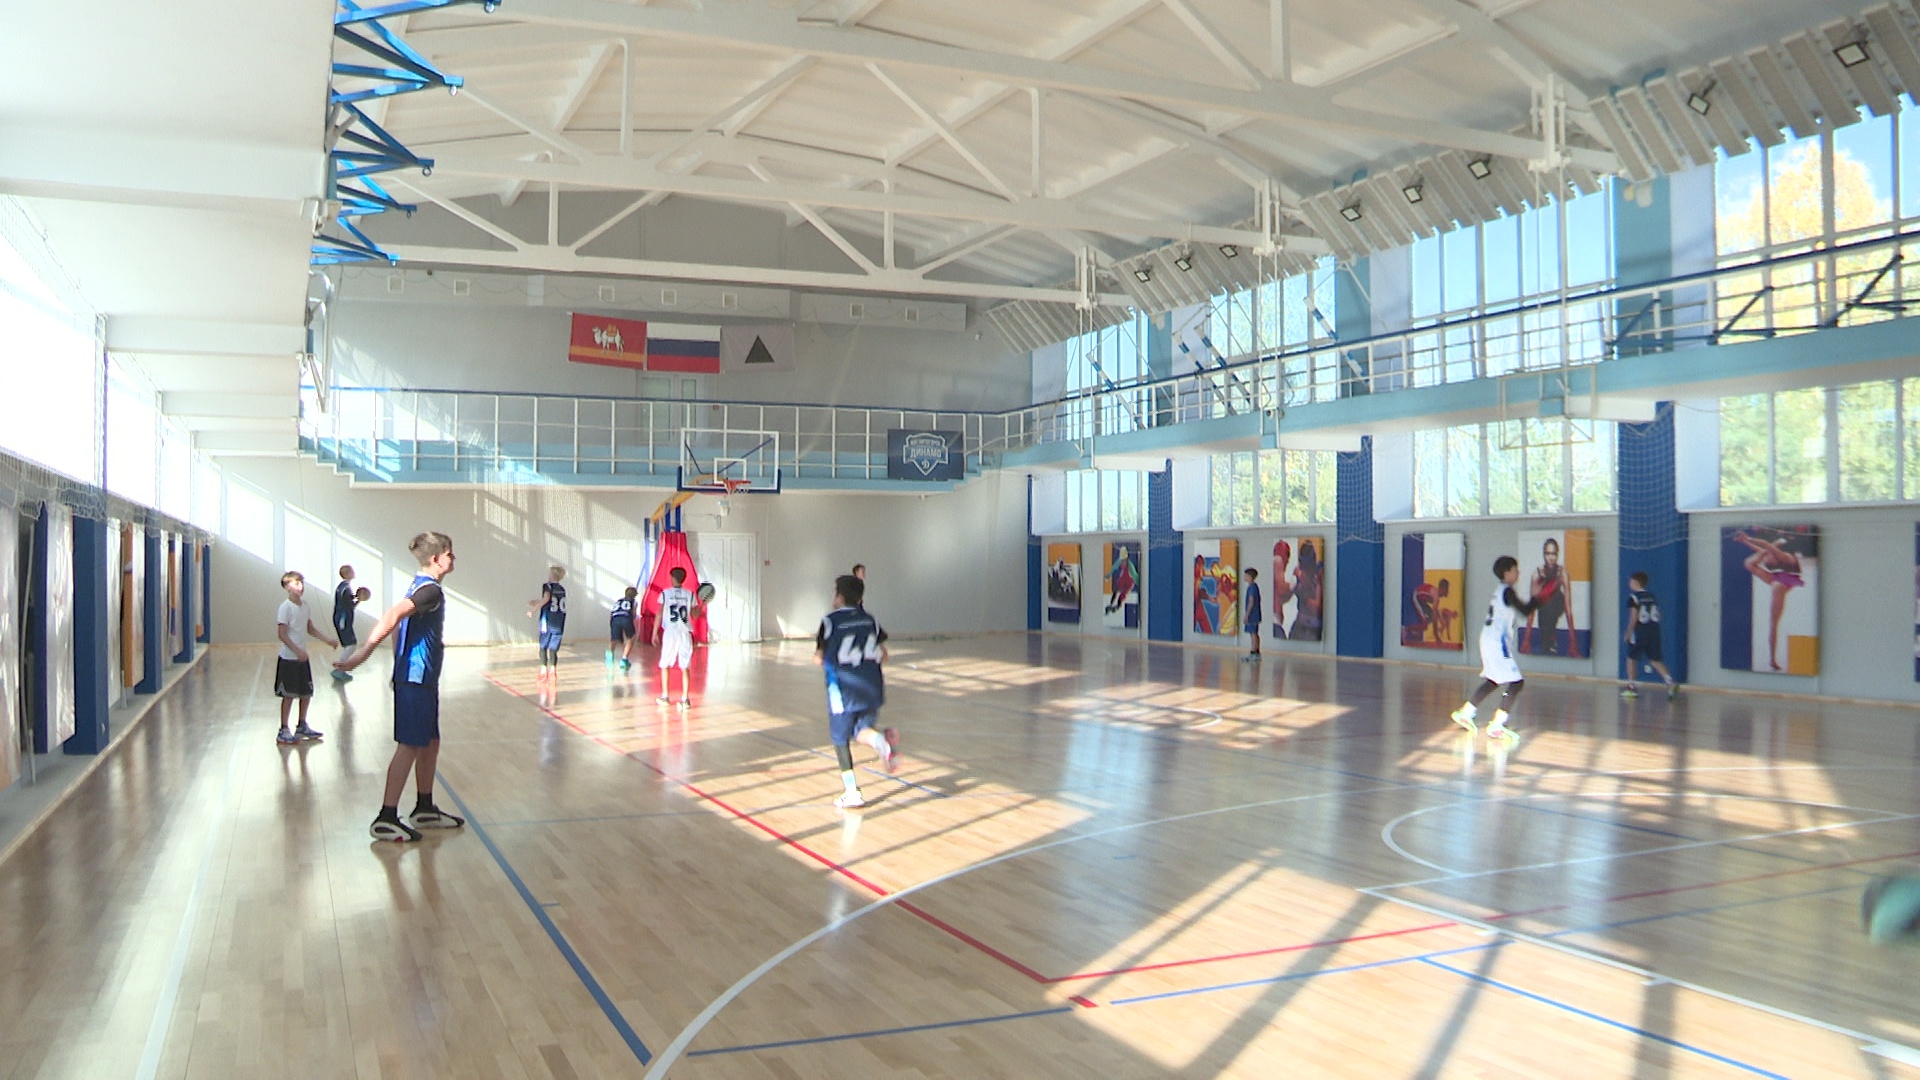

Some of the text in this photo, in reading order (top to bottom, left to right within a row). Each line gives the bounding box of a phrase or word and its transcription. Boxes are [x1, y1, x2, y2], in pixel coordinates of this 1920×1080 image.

[910, 447, 941, 458] ДИНАМО
[669, 604, 688, 623] 50
[837, 633, 882, 668] 44
